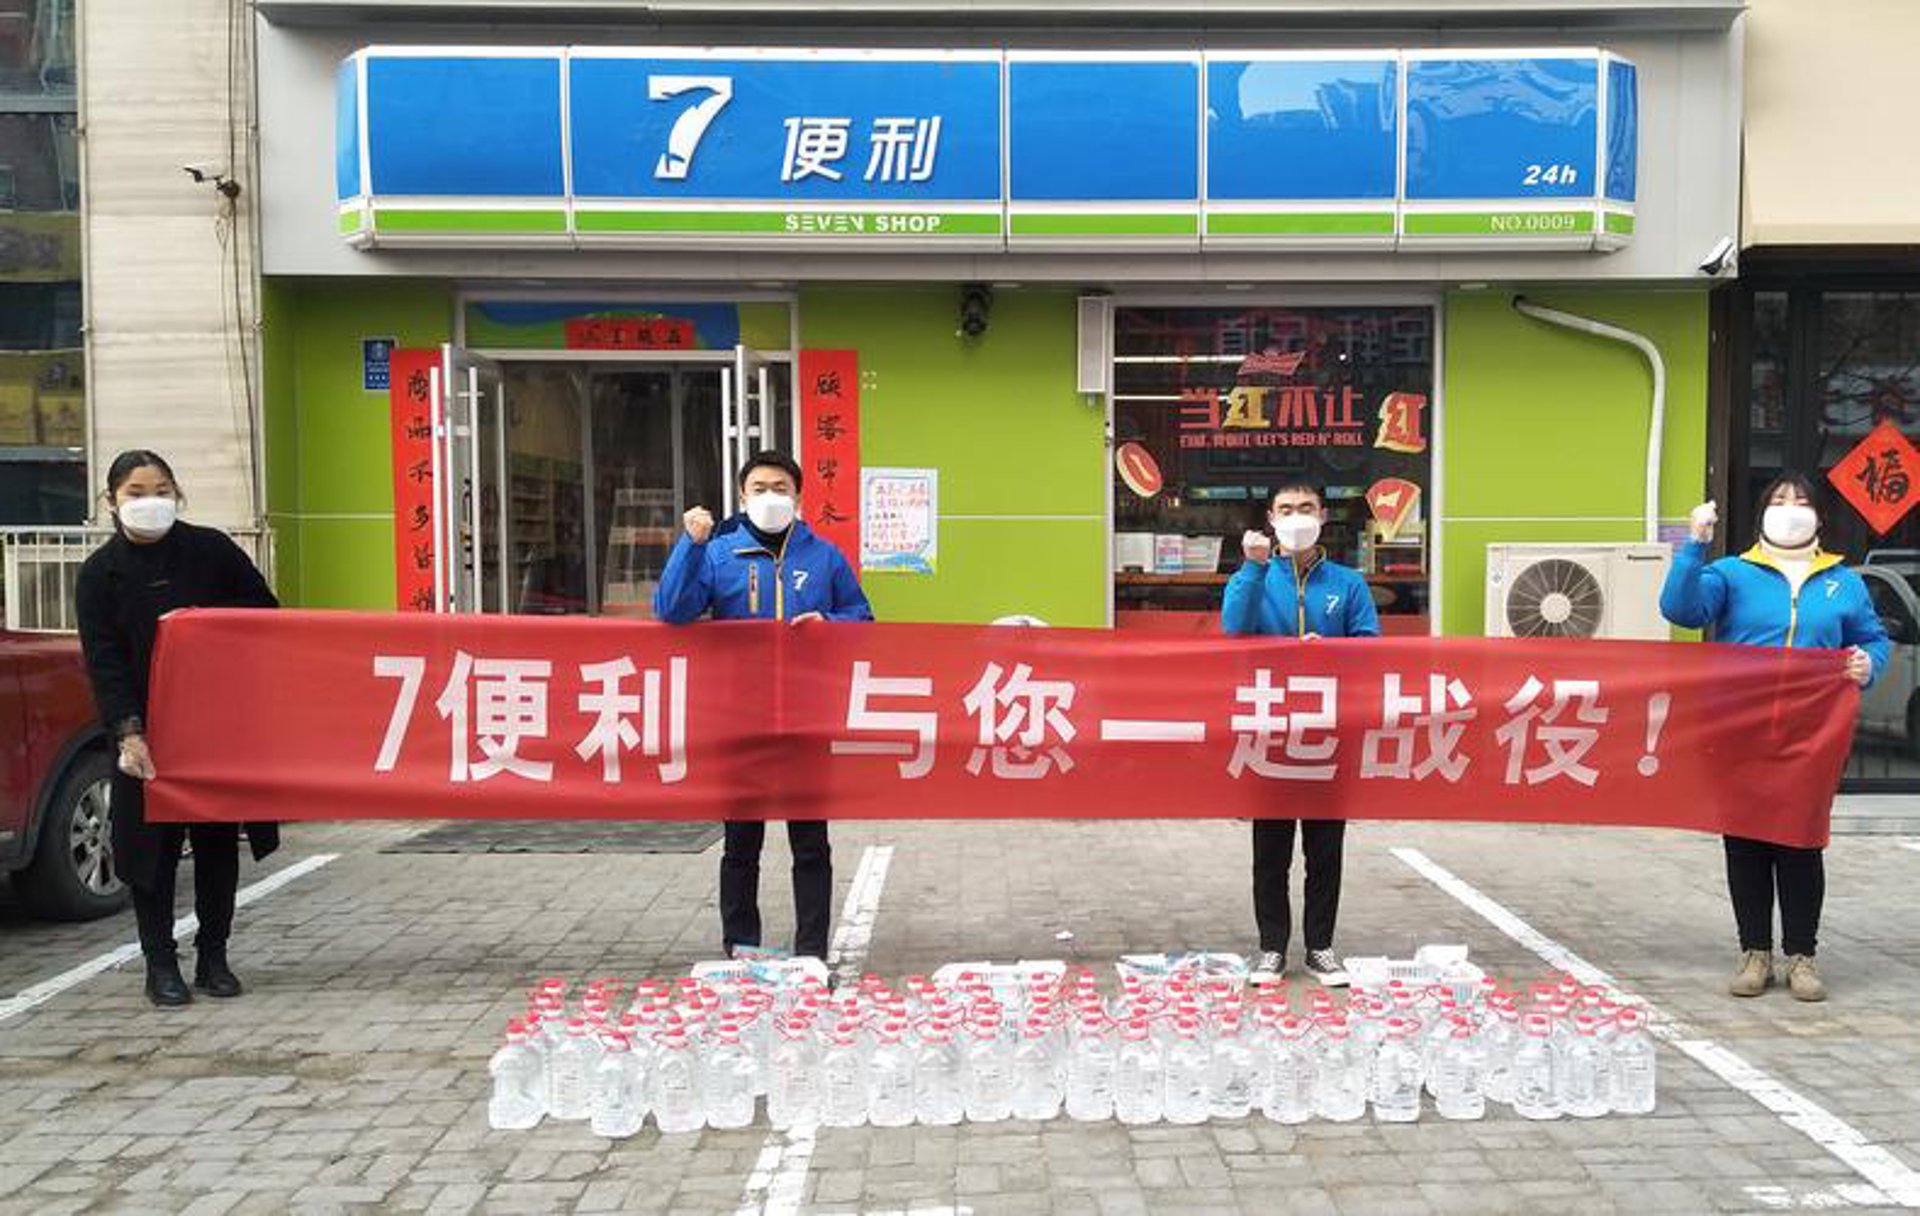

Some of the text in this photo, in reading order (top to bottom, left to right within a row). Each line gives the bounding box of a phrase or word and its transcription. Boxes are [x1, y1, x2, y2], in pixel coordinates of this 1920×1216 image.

[648, 75, 942, 183] 7 便利
[1523, 164, 1577, 186] 24h
[784, 213, 942, 232] SEVEN SHOP
[1855, 448, 1910, 506] 福
[373, 650, 688, 783] 7便利
